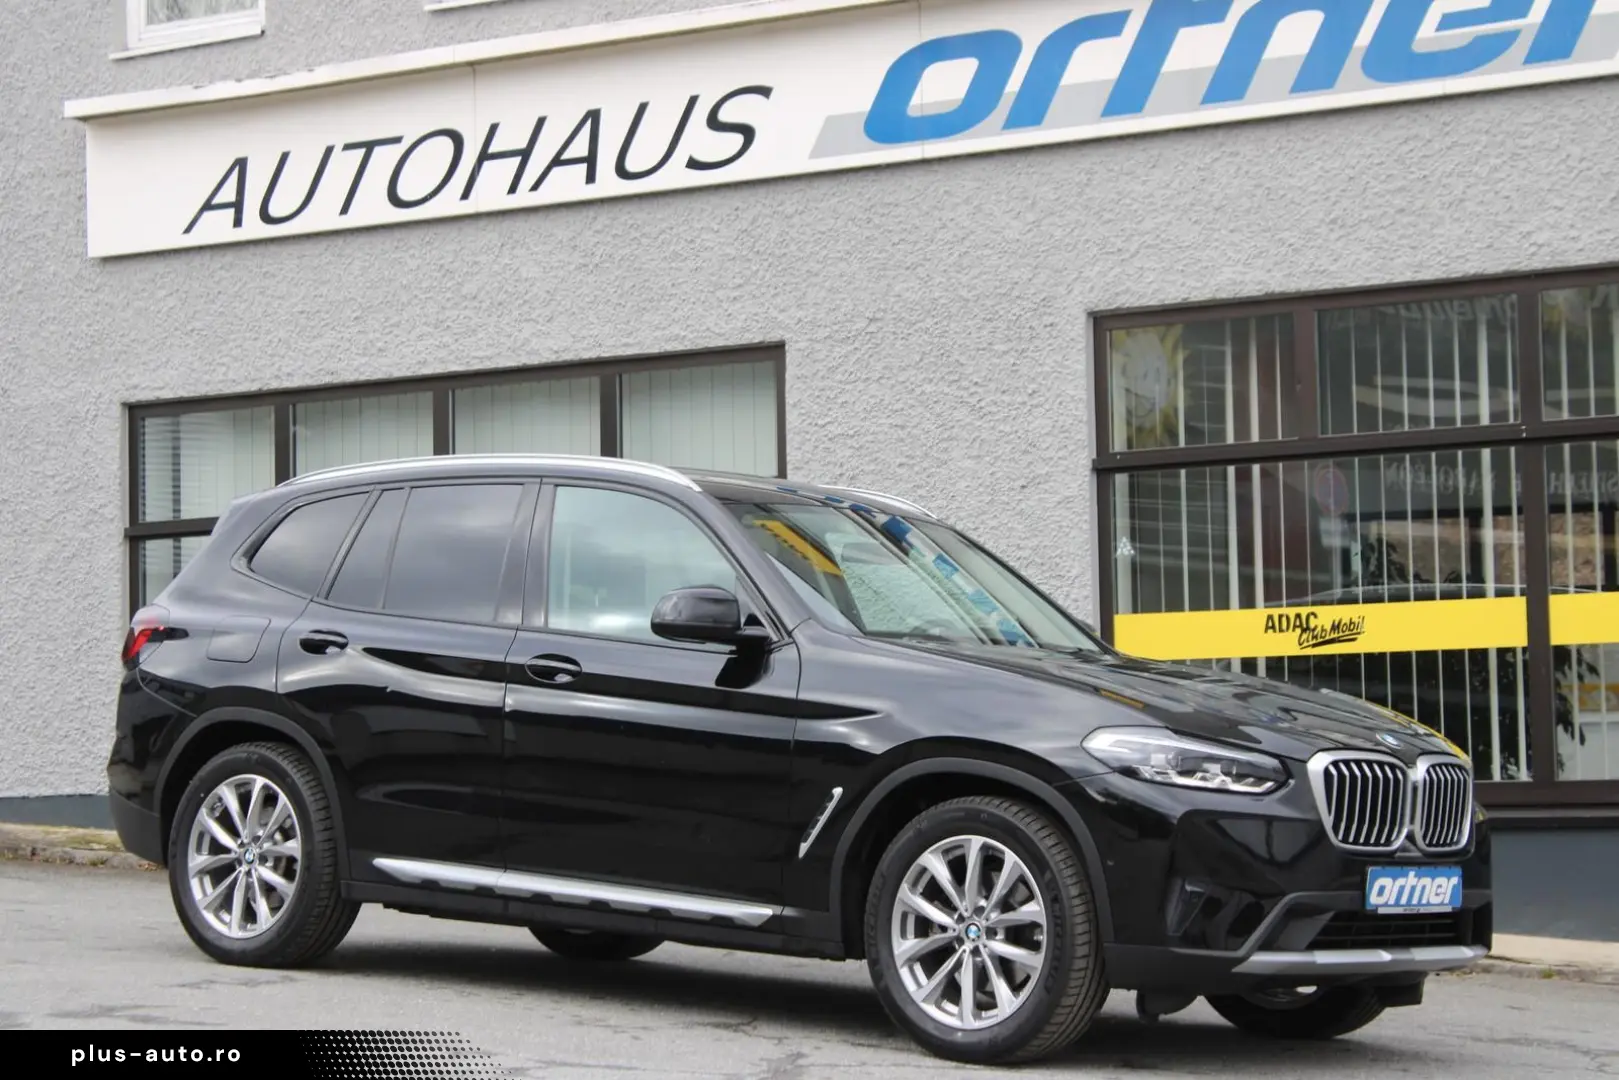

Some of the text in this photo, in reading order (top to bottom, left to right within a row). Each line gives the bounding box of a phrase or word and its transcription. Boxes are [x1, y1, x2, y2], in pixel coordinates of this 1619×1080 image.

[183, 85, 773, 235] AUTOHAUS
[1264, 611, 1318, 635] ADAC
[1369, 870, 1459, 905] ortner
